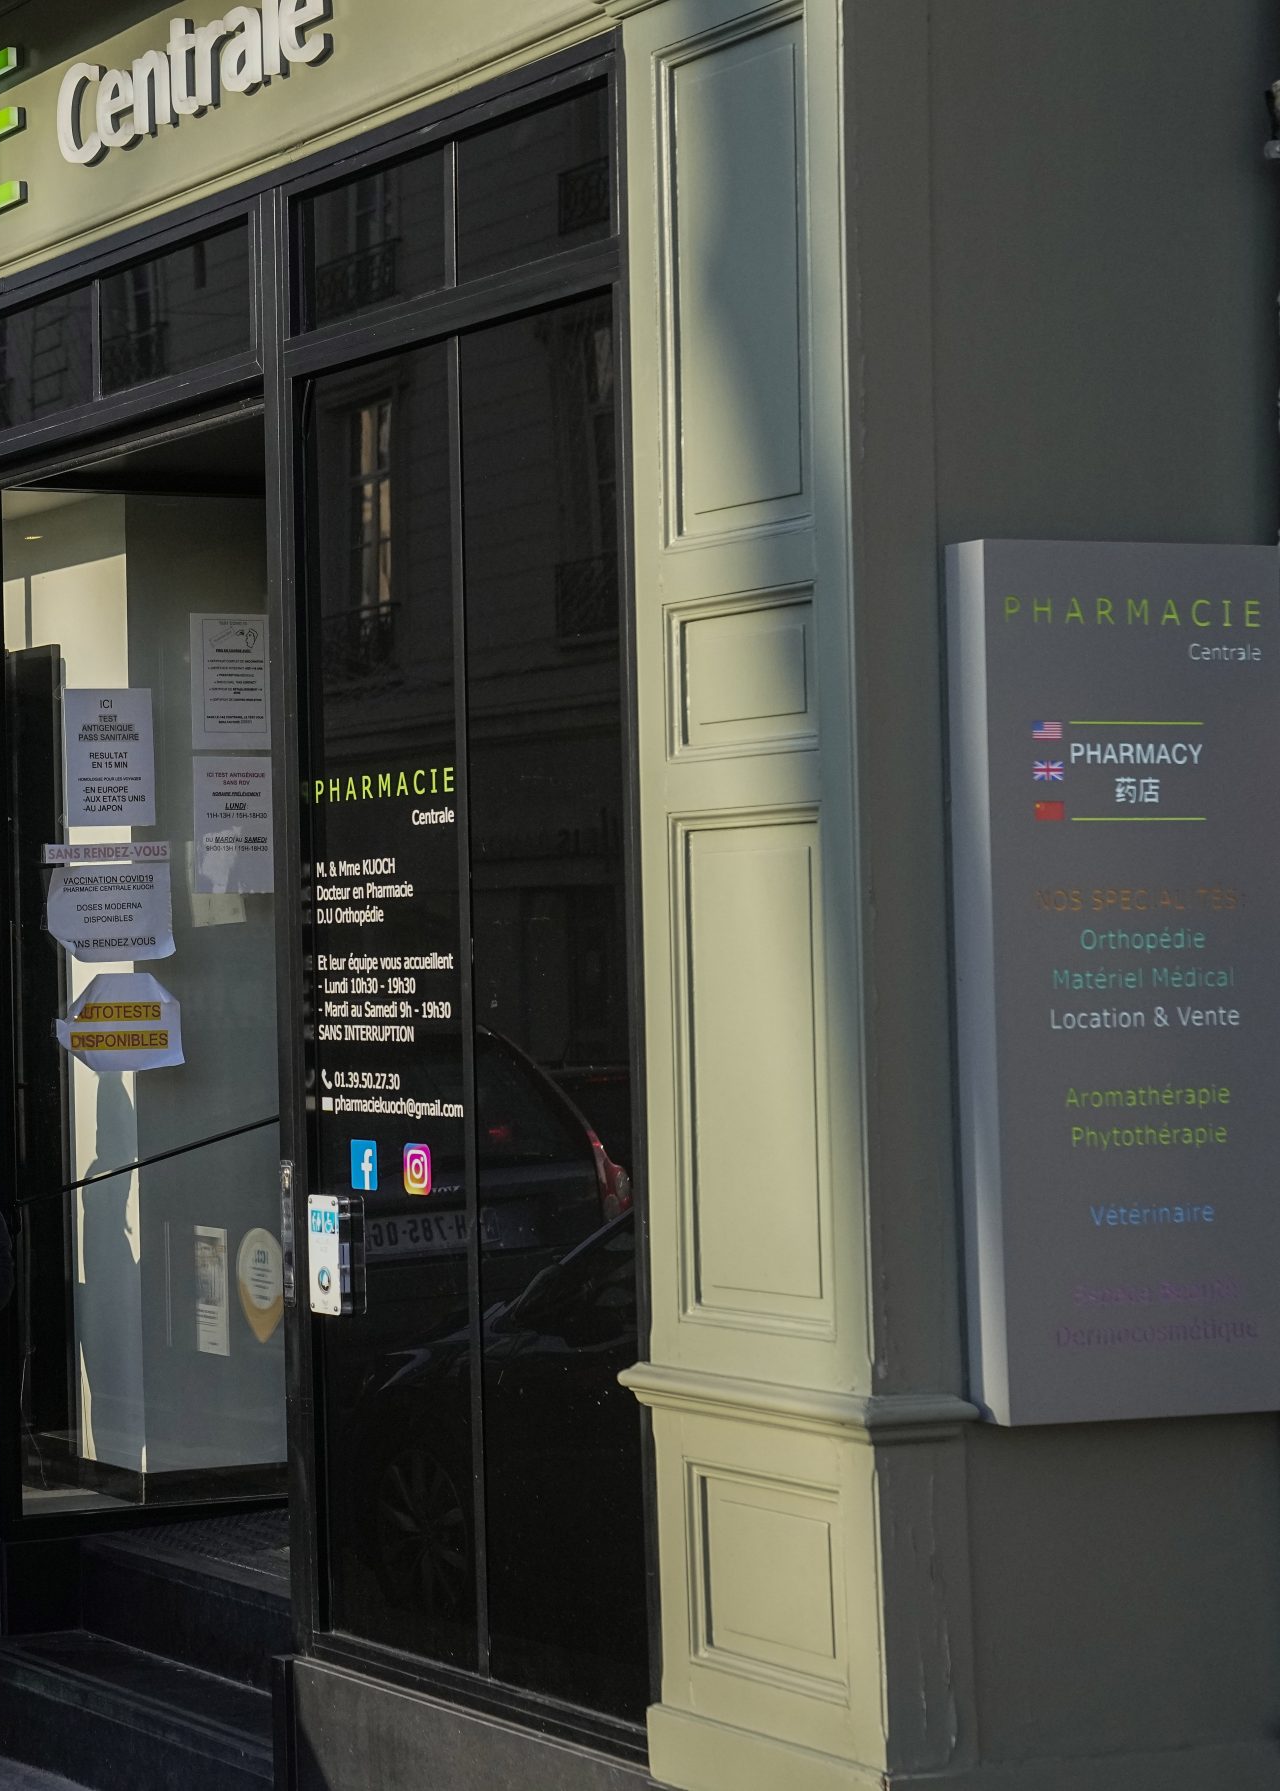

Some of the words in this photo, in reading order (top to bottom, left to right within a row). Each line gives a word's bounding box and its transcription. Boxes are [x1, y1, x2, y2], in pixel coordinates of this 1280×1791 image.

[56, 0, 325, 164] Centrale
[1003, 595, 1262, 628] PHARMACIE
[1188, 642, 1262, 661] Centrale
[100, 699, 113, 709] ICI
[82, 724, 134, 732] ANTIGENIQUE
[98, 715, 118, 723] TEST
[78, 734, 98, 742] PASS
[100, 733, 140, 741] SANITAIRE
[89, 752, 128, 760] RESULTAT
[1070, 743, 1203, 765] PHARMACY
[114, 761, 128, 769] MIN
[315, 767, 455, 804] PHARMACIE
[1115, 777, 1160, 804] 药店
[98, 804, 123, 812] JAPON
[411, 807, 455, 826] Centrale
[48, 848, 81, 860] SANS
[83, 845, 168, 859] RENDEZ-VOUS
[316, 862, 327, 878] M.
[329, 861, 337, 876] &
[339, 860, 361, 876] Mme
[362, 857, 396, 875] KUOCH
[63, 875, 118, 885] VACCINATION
[119, 874, 154, 884] COVID19
[317, 884, 351, 901] Docteur
[353, 887, 364, 900] en
[366, 881, 414, 899] Pharmacie
[76, 903, 103, 911] DOSES
[104, 902, 143, 910] MODERNA
[317, 908, 332, 924] D.U
[335, 905, 384, 926] Orthopédie
[83, 914, 134, 923] DISPONIBLES
[67, 939, 91, 949] ANS
[92, 938, 129, 948] RENDEZ
[131, 936, 156, 946] VOUS
[1080, 927, 1206, 954] Orthopédie
[318, 954, 327, 971] Et
[329, 954, 346, 971] leur
[348, 952, 378, 974] équipe
[380, 957, 402, 970] vous
[403, 952, 454, 970] accueillent
[324, 977, 349, 994] Lundi
[350, 977, 378, 994] 10h30
[387, 977, 416, 994] 19h30
[1052, 966, 1143, 989] Matériel
[1152, 965, 1235, 988] Médical
[324, 1001, 349, 1018] Mardi
[350, 1005, 362, 1018] au
[364, 1001, 398, 1018] Samedi
[400, 1001, 412, 1018] 9h
[422, 1002, 452, 1019] 19h30
[1050, 1007, 1145, 1029] Location
[1153, 1006, 1169, 1027] &
[1176, 1006, 1241, 1027] Vente
[71, 1033, 168, 1048] DISPONIBLES
[318, 1024, 343, 1041] SANS
[344, 1024, 415, 1042] INTERRUPTION
[334, 1071, 401, 1090] 01.39.50.27.30
[1066, 1083, 1231, 1109] Aromathérapie
[334, 1094, 464, 1119] pharmaciekuoch@gmail.com
[1071, 1122, 1228, 1150] Phytothérapie
